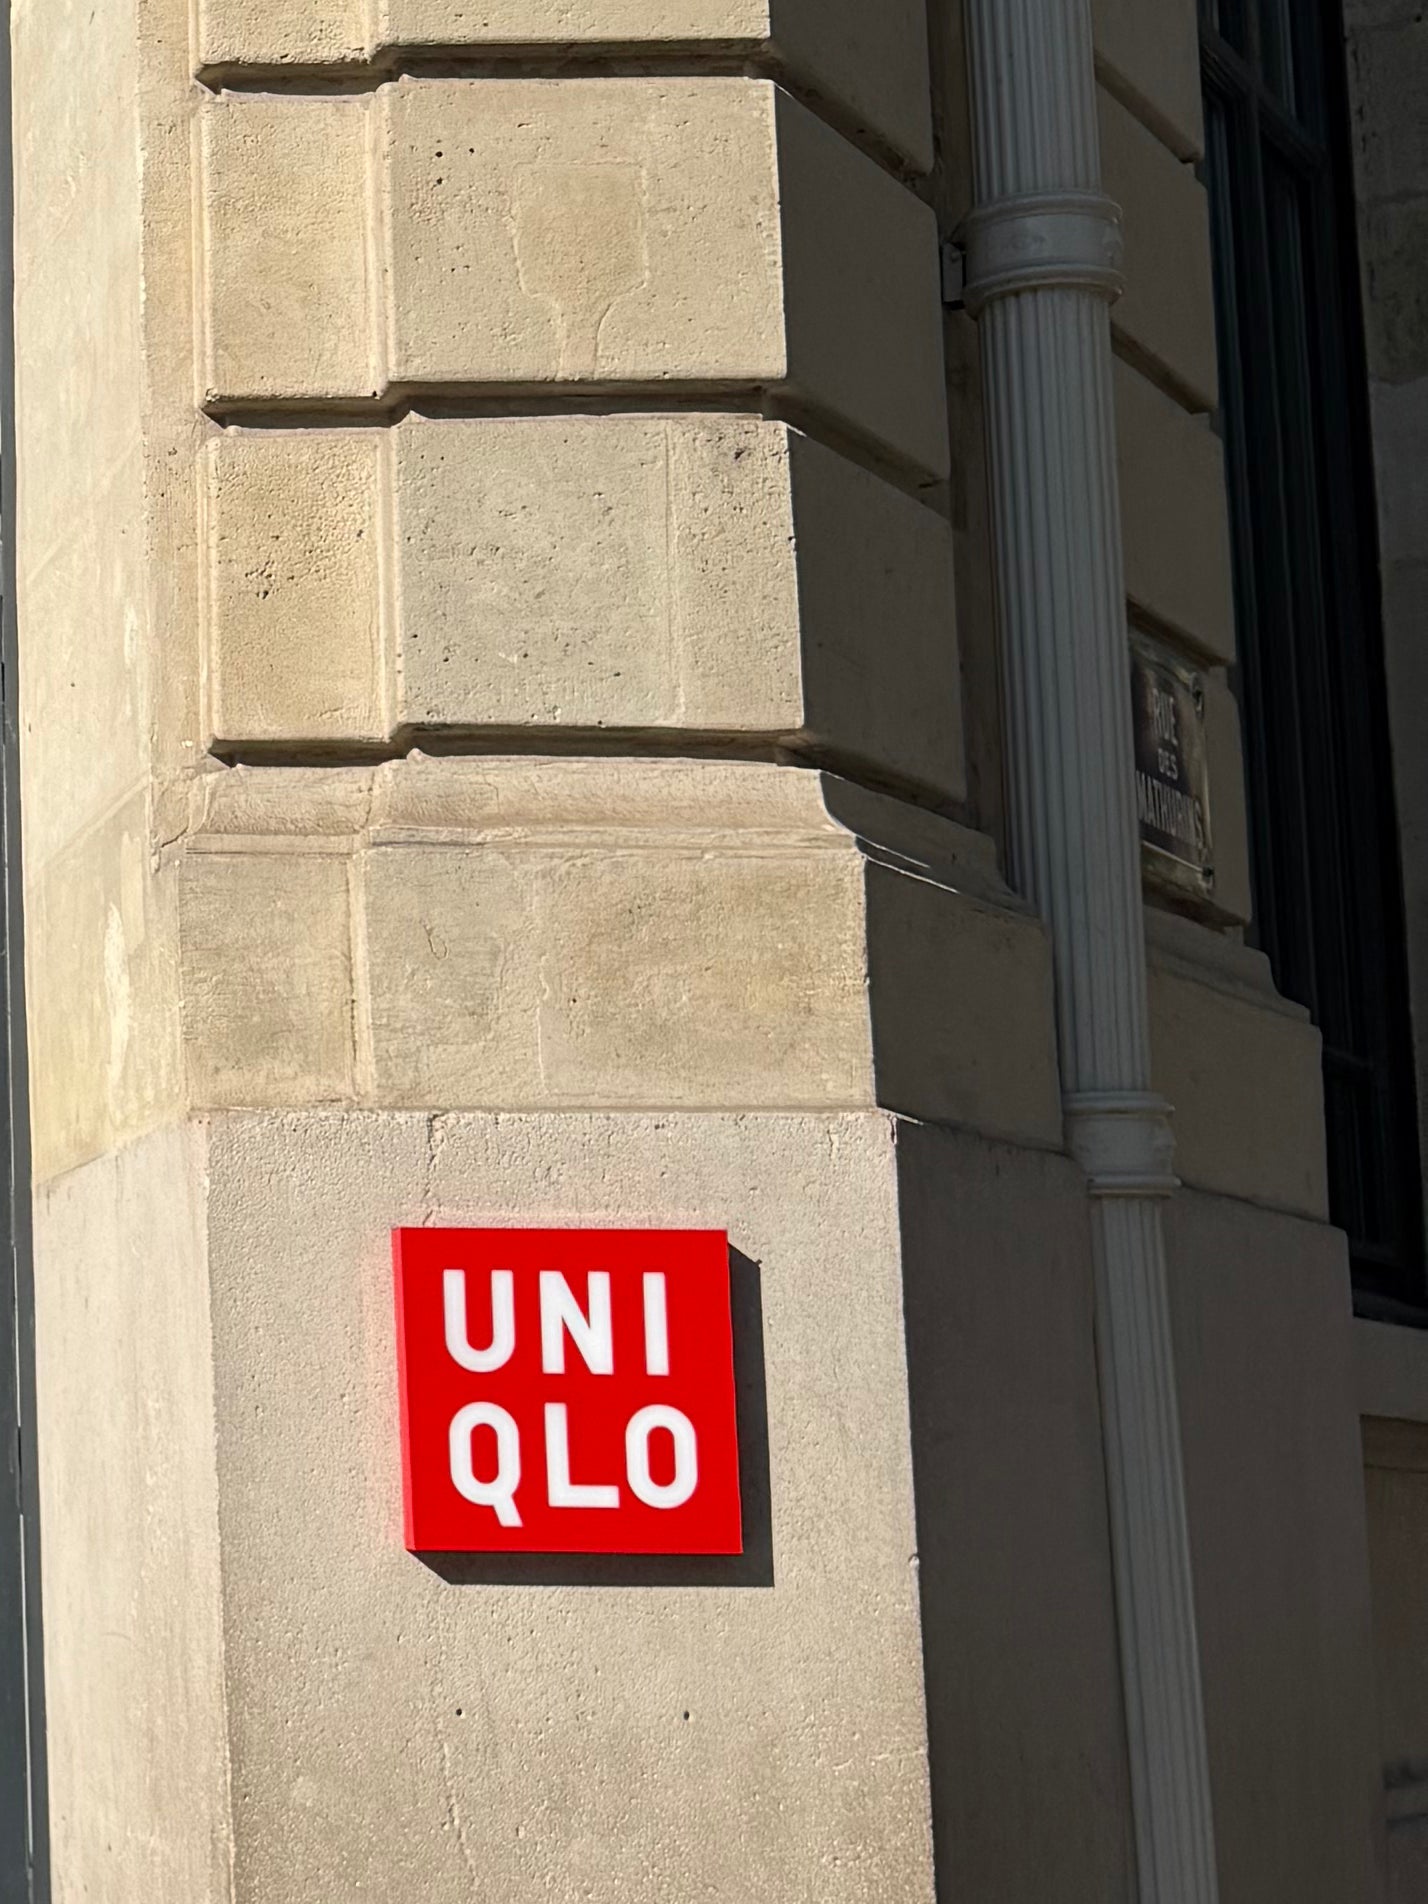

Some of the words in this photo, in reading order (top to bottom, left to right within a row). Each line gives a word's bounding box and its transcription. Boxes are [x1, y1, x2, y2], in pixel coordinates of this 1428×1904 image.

[1151, 687, 1179, 747] RUE
[1157, 747, 1179, 781] DES
[442, 1268, 670, 1377] UNI
[448, 1401, 699, 1528] QLO
